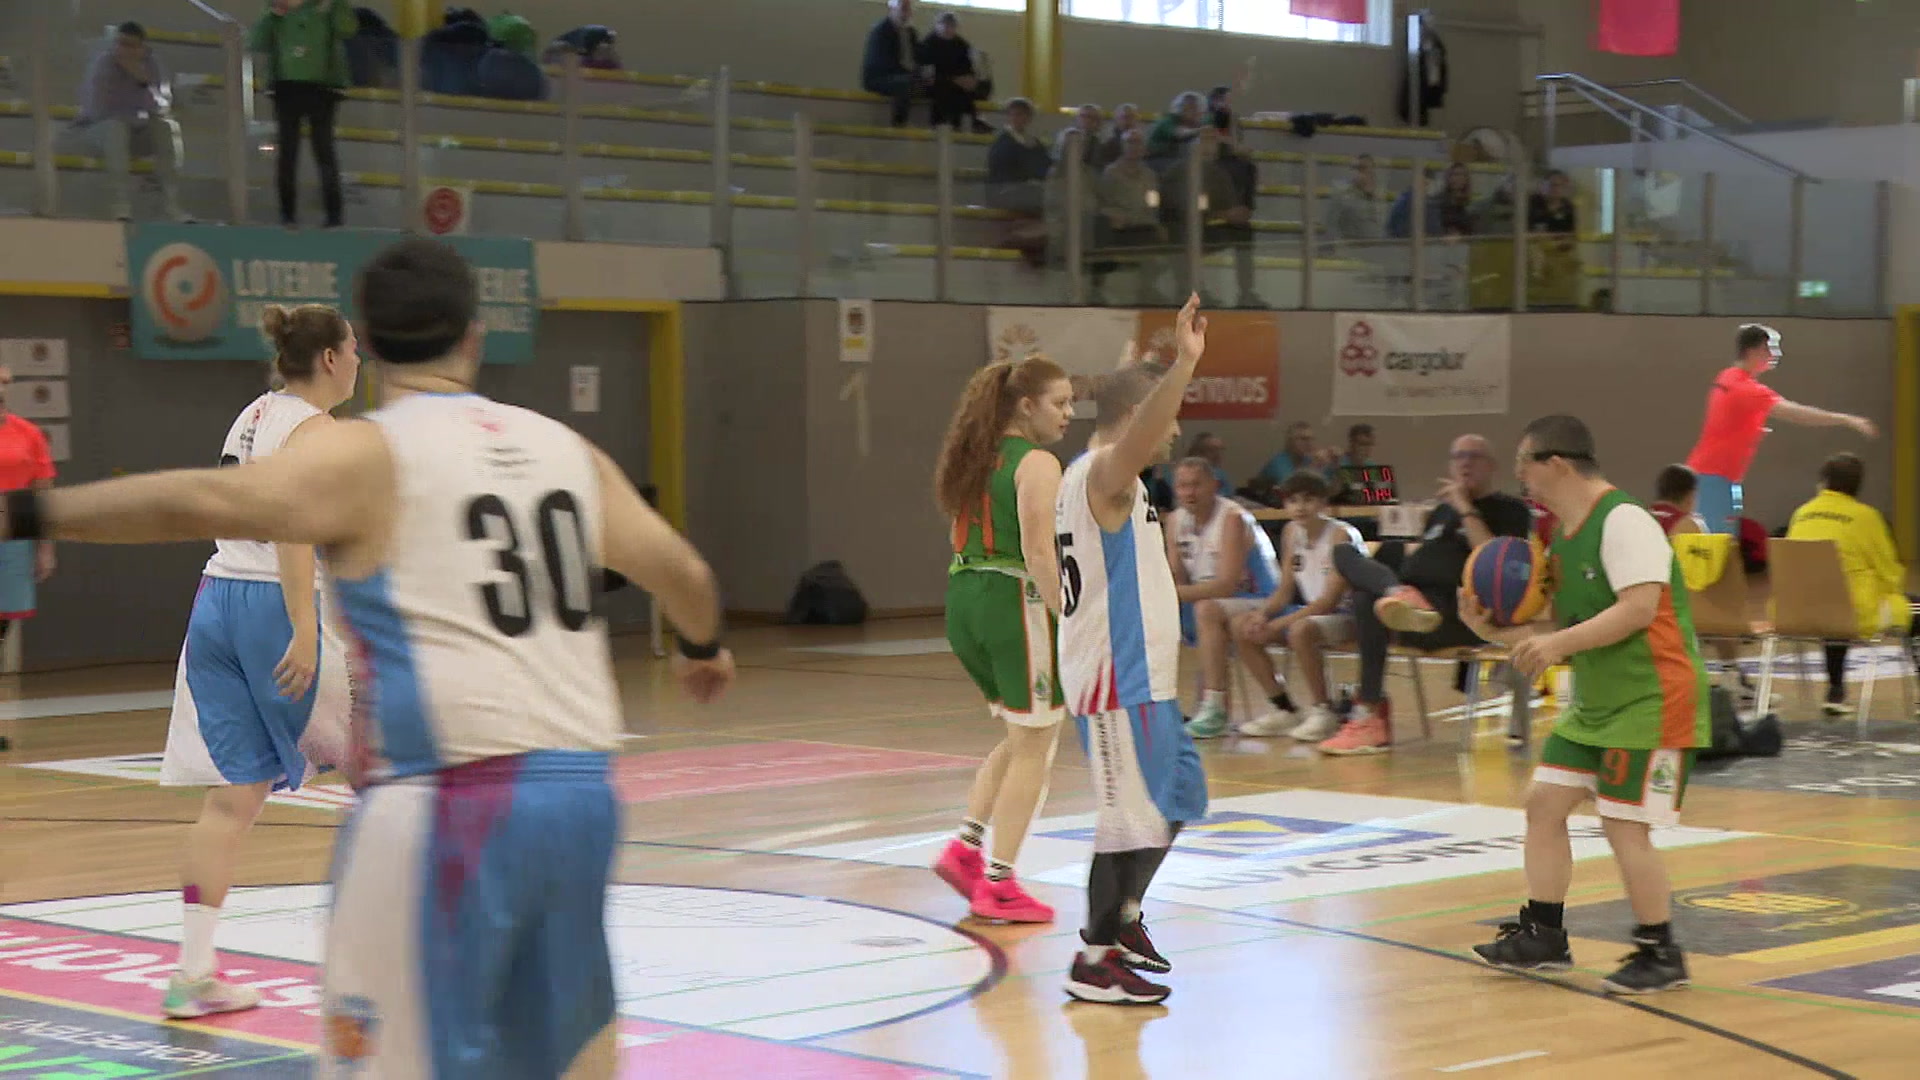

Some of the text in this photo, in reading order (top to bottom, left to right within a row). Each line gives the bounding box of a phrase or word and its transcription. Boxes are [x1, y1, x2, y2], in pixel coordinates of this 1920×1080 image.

[232, 258, 340, 298] LOTERIE
[473, 266, 530, 304] ERIE
[465, 487, 592, 638] 30
[1602, 748, 1631, 786] 9
